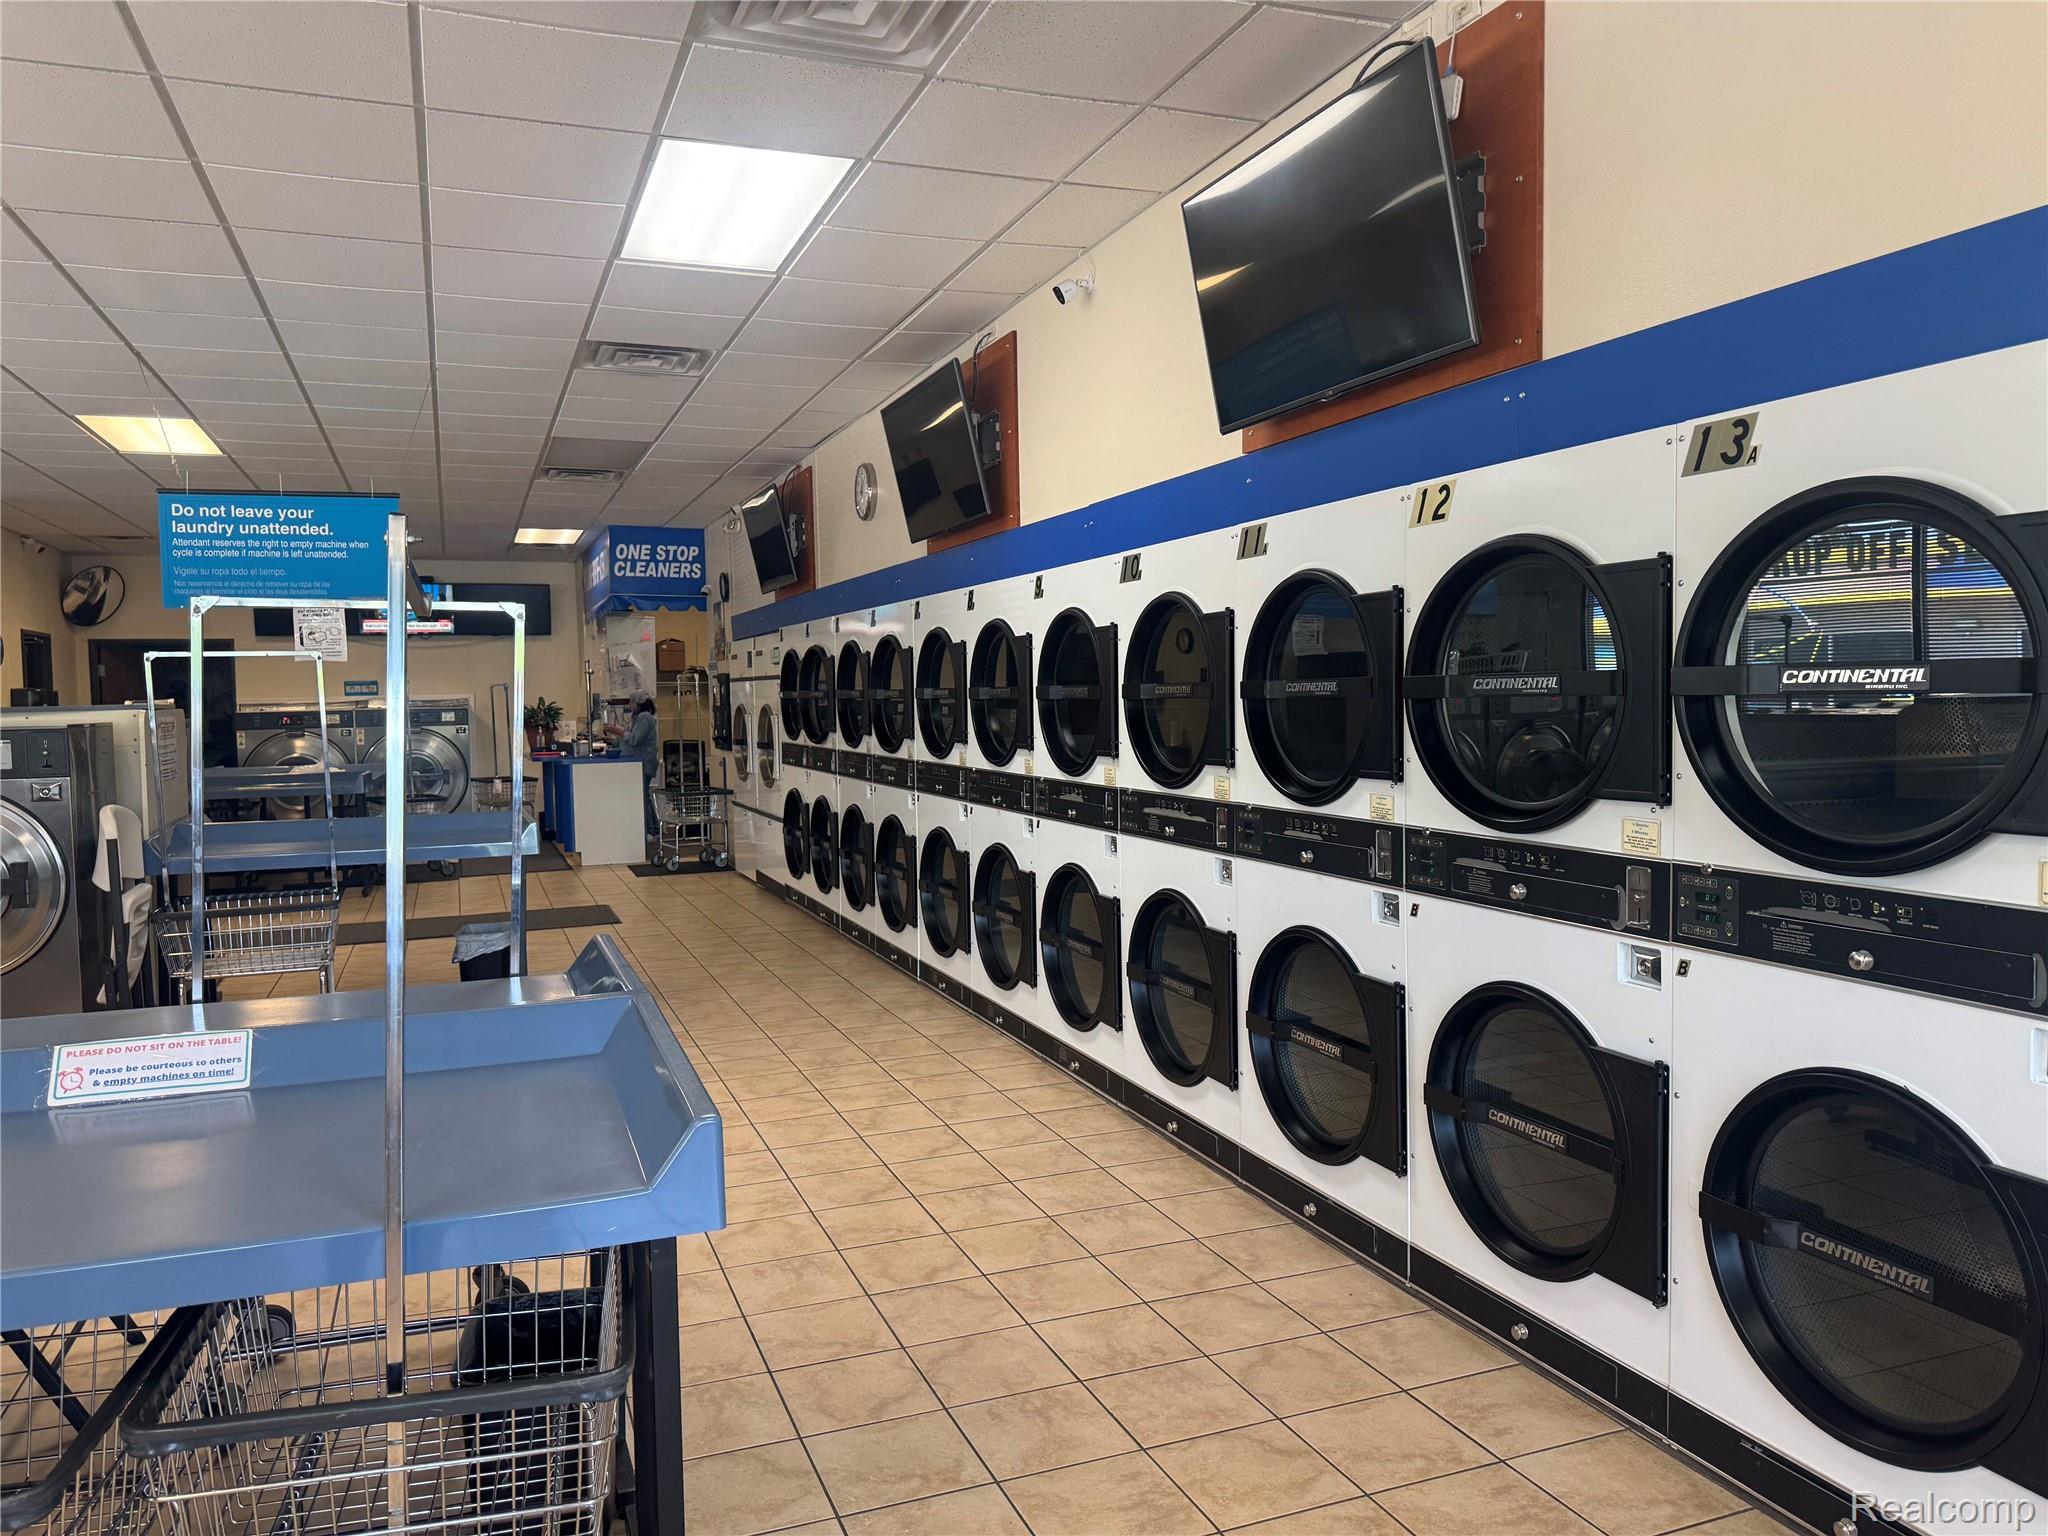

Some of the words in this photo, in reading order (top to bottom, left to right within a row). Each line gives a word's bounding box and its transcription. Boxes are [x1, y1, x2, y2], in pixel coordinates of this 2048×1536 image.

[172, 504, 194, 517] Do
[199, 504, 226, 518] not
[231, 505, 274, 519] leave
[278, 507, 314, 521] your
[1416, 484, 1451, 524] 12
[172, 521, 234, 536] laundry
[239, 522, 334, 536] unattended.
[172, 538, 211, 548] Attendant
[212, 540, 246, 548] reserves
[248, 539, 260, 548] the
[262, 539, 279, 551] right
[280, 540, 288, 549] to
[290, 541, 314, 552] empty
[315, 540, 347, 549] machine
[348, 541, 368, 550] when
[616, 544, 651, 560] ONE
[656, 545, 699, 561] STOP
[172, 548, 194, 559] cycle
[195, 549, 202, 557] is
[204, 548, 240, 560] complete
[241, 549, 247, 558] if
[248, 549, 282, 558] machine
[282, 550, 290, 558] is
[290, 550, 303, 558] left
[304, 550, 348, 559] unattended.
[212, 568, 229, 577] ropa
[232, 567, 248, 576] todo
[250, 567, 258, 576] el
[259, 567, 286, 578] tiempo.
[614, 561, 702, 578] CLEANERS
[1473, 676, 1558, 690] CONTINENTAL
[1782, 668, 1926, 684] CONTINENTAL
[1286, 681, 1338, 692] CONTINENTAL
[1411, 904, 1418, 916] B
[1678, 960, 1689, 976] B
[66, 1048, 104, 1058] PLEASE
[106, 1046, 122, 1055] DO
[125, 1044, 146, 1054] NOT
[150, 1043, 166, 1051] SIT
[168, 1041, 184, 1050] ON
[187, 1040, 206, 1048] THE
[209, 1036, 242, 1046] TABLE!
[1290, 1025, 1341, 1057] CONTINENTAL
[89, 1066, 122, 1076] Please
[126, 1065, 138, 1073] be
[141, 1061, 193, 1071] courteous
[210, 1056, 242, 1066] others
[103, 1077, 138, 1087] empty
[140, 1072, 190, 1082] machines
[192, 1070, 206, 1078] on
[208, 1068, 234, 1078] time!
[1488, 1108, 1565, 1148] CONTINENTAL
[1801, 1230, 1930, 1294] CONTINENTAL
